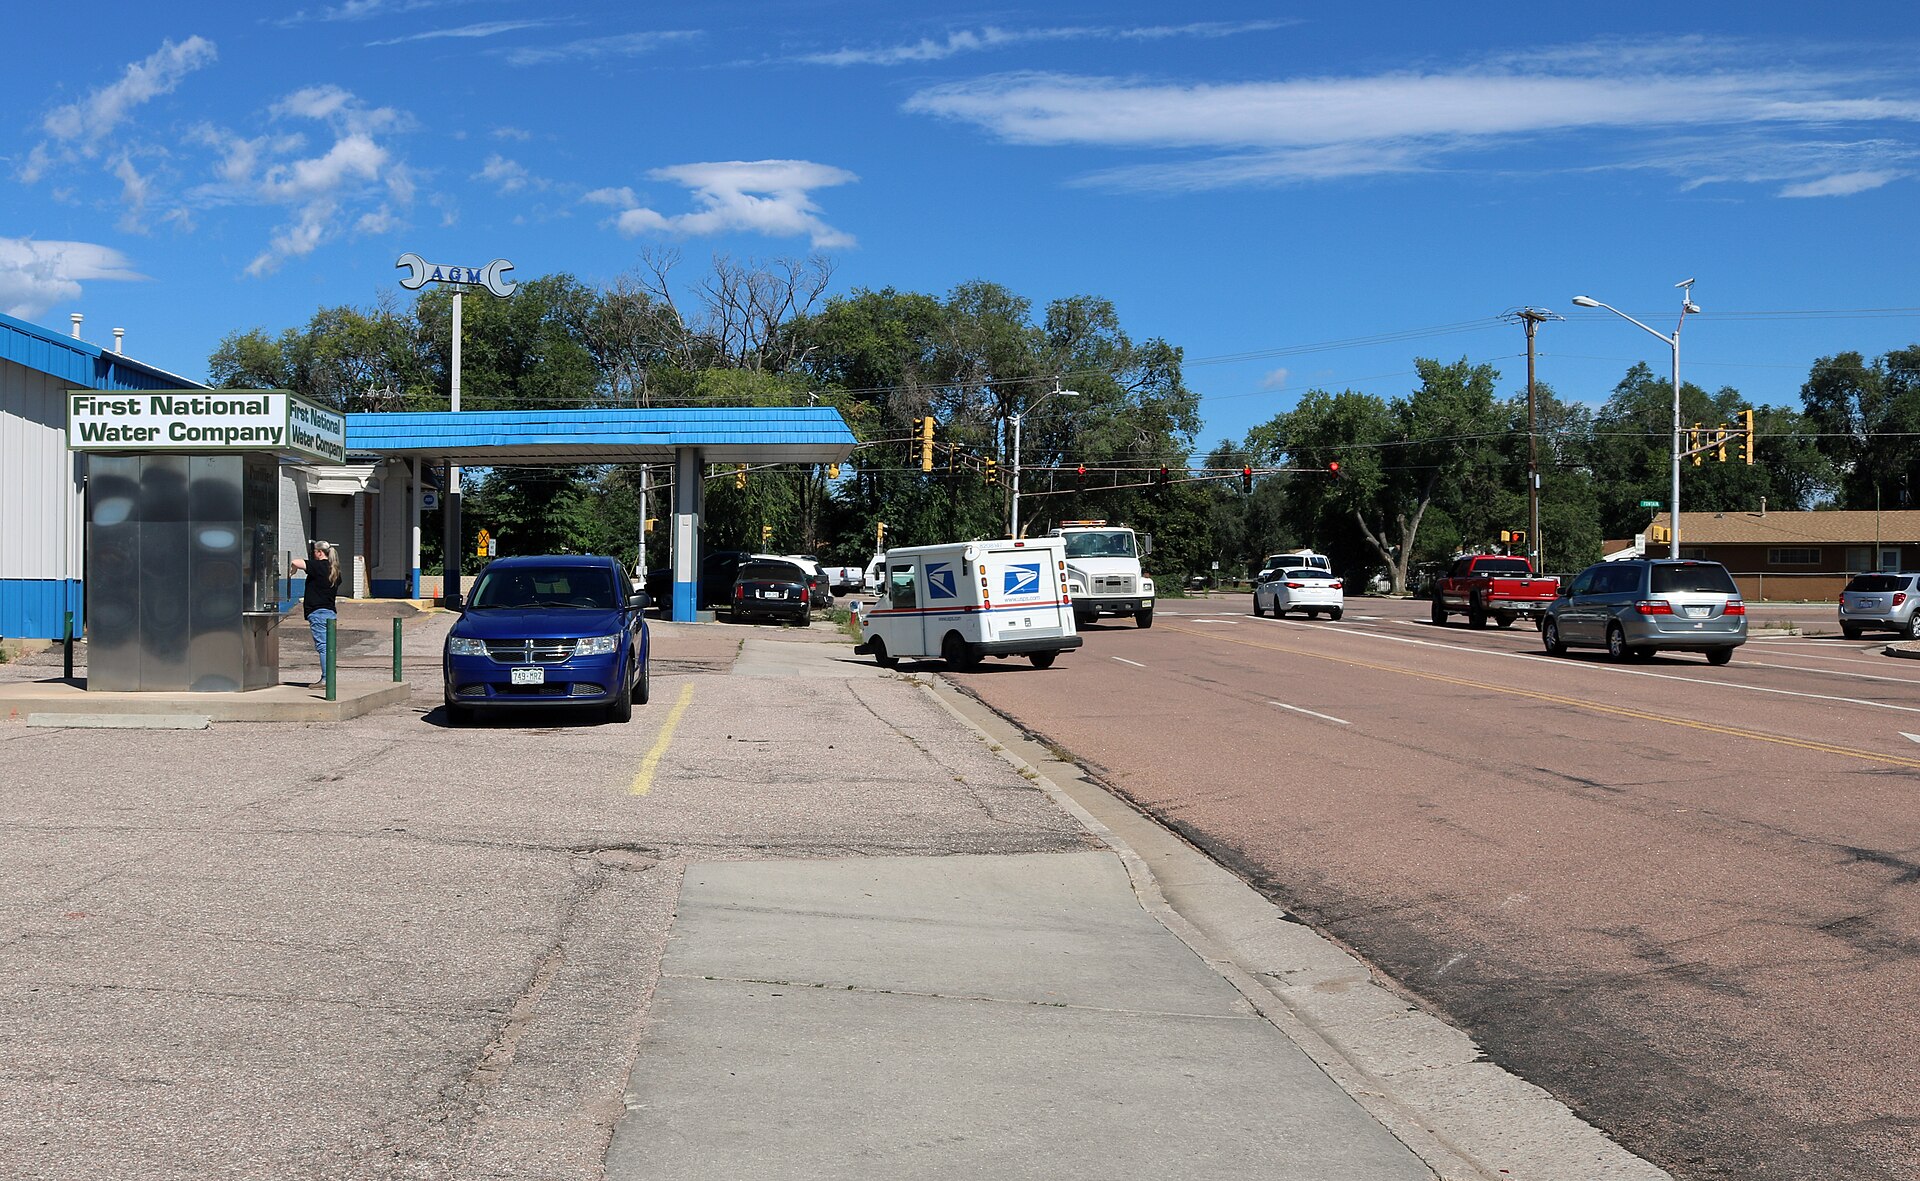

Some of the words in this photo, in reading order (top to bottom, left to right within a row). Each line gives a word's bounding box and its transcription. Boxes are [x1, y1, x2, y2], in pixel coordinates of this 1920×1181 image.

[432, 266, 482, 284] AGM
[73, 396, 142, 415] First
[150, 396, 270, 415] National
[290, 400, 308, 423] First
[310, 408, 340, 435] National
[79, 422, 160, 442] Water
[168, 421, 284, 445] Company
[292, 424, 314, 448] Water
[316, 433, 343, 461] Company
